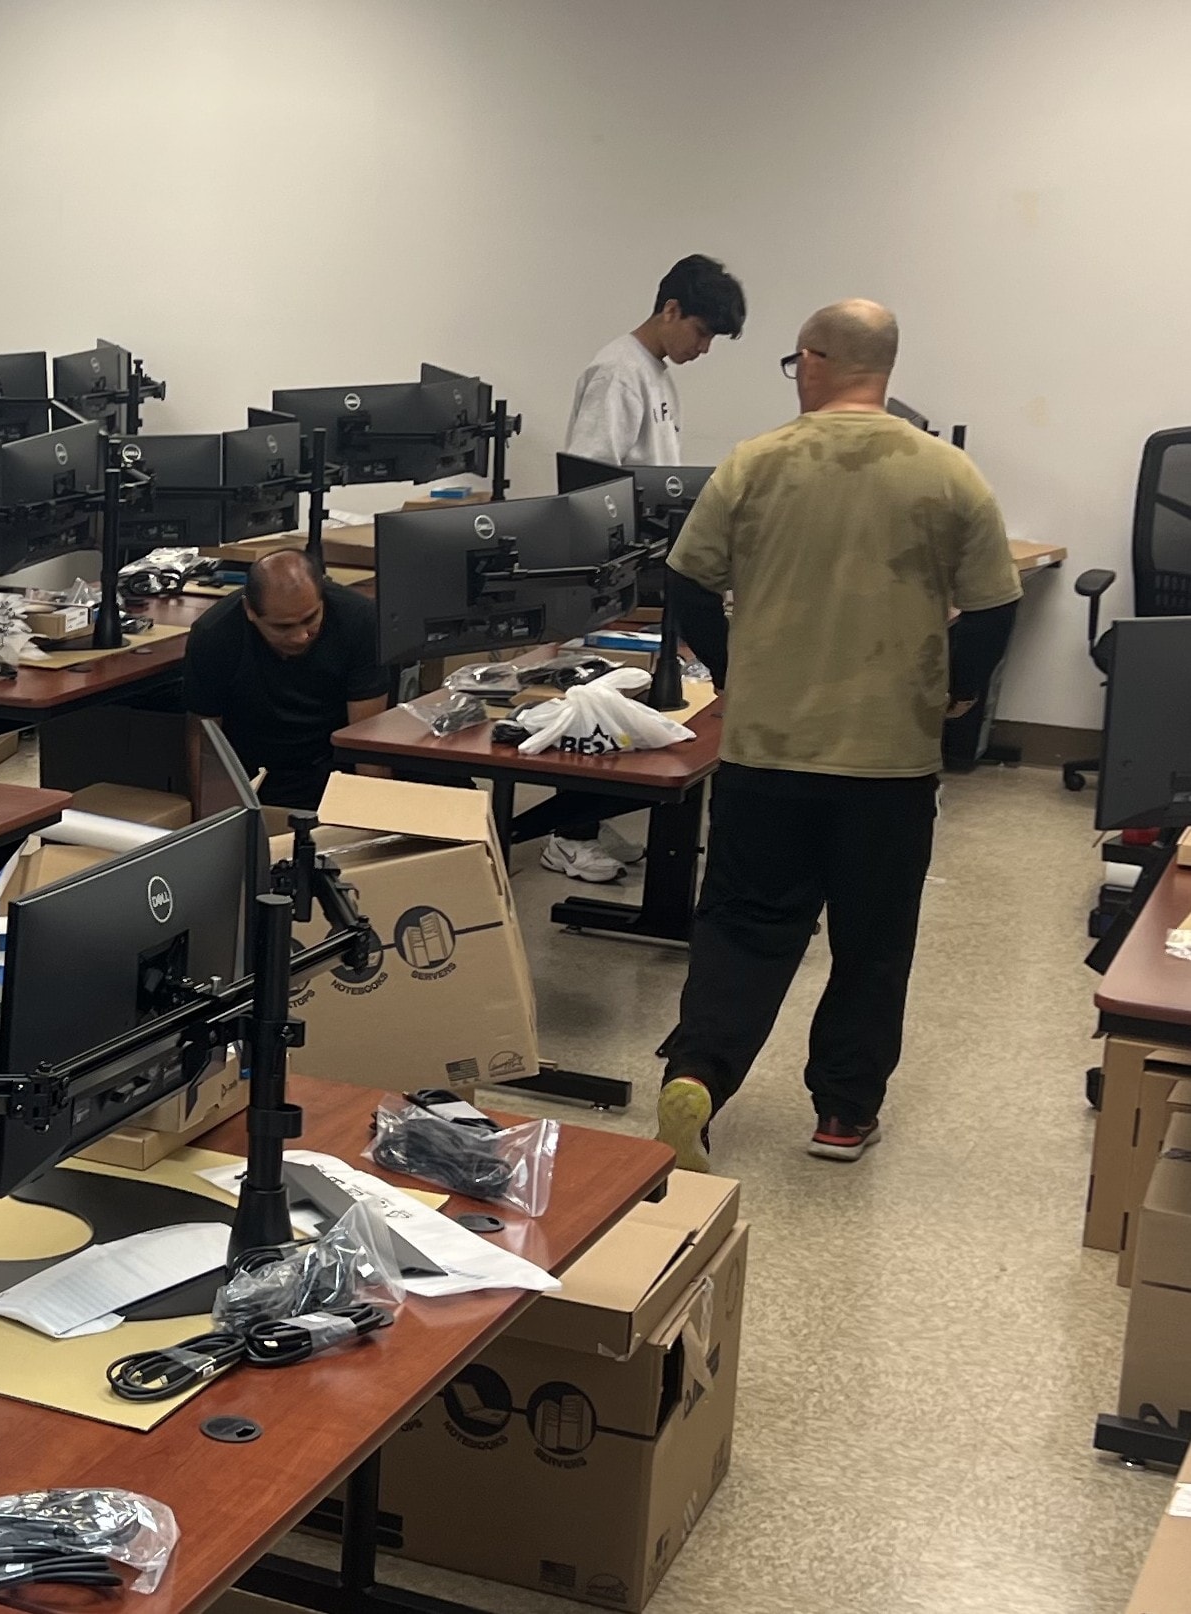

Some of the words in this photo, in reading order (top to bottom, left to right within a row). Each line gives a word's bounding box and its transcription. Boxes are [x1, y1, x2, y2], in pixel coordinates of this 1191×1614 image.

[151, 891, 170, 908] DELL
[410, 961, 457, 981] SERVERS
[330, 971, 389, 996] NOTEBOOKS
